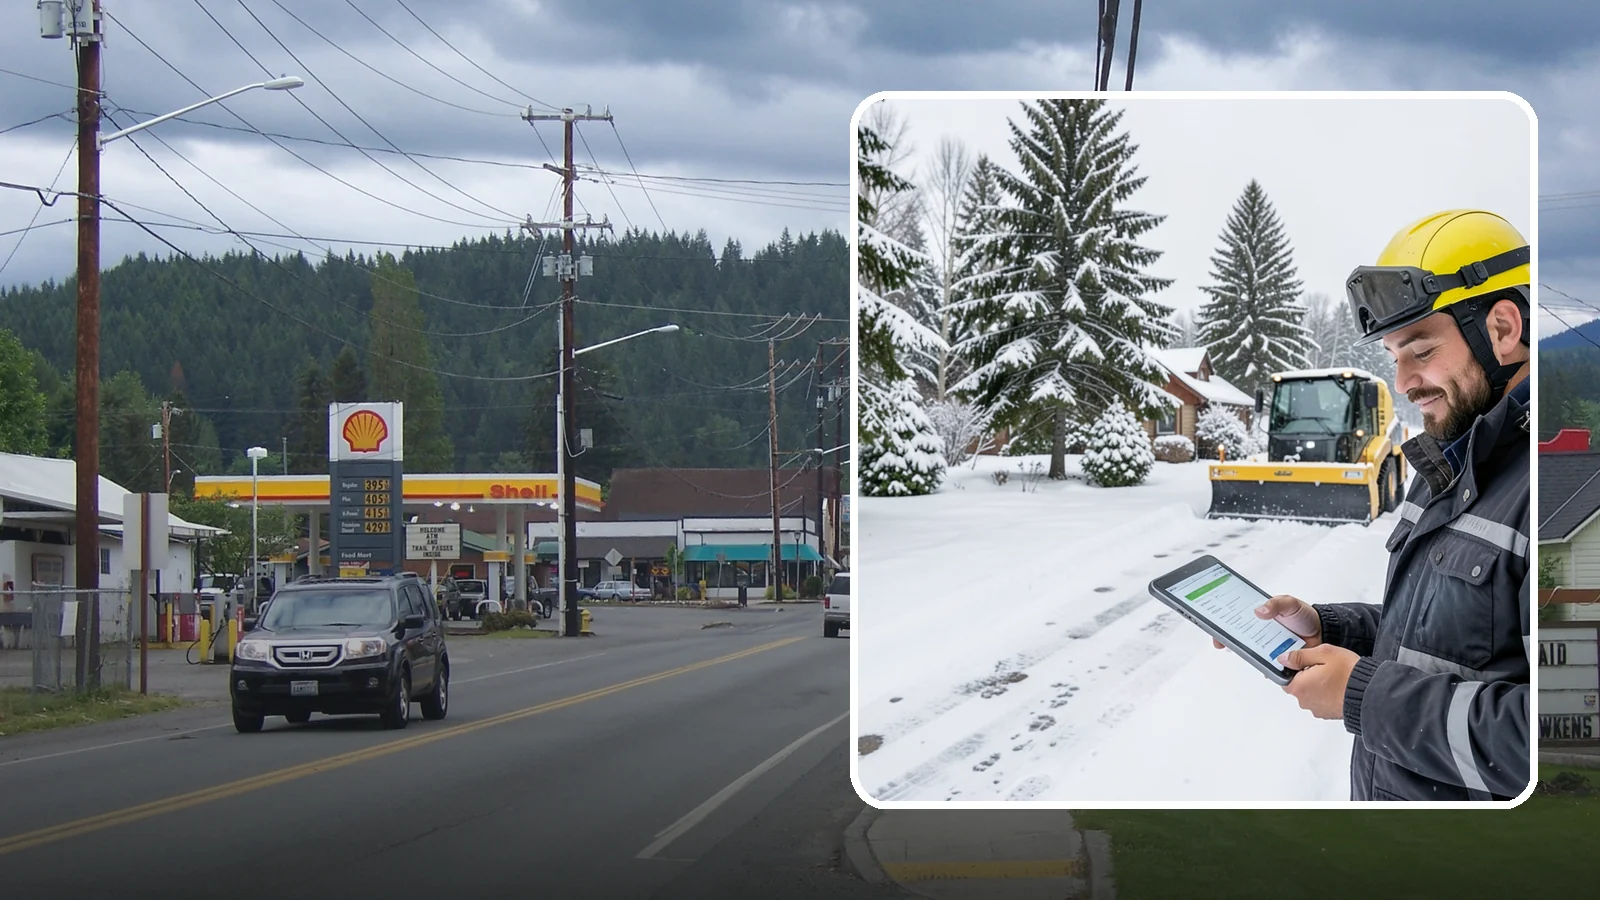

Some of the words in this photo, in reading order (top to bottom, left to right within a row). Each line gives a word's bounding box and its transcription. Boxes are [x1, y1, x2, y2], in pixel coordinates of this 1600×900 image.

[366, 480, 383, 490] 395
[490, 484, 547, 499] Shell
[366, 495, 383, 504] 405
[366, 508, 383, 518] 415
[366, 522, 383, 532] 429
[1538, 643, 1566, 665] AID
